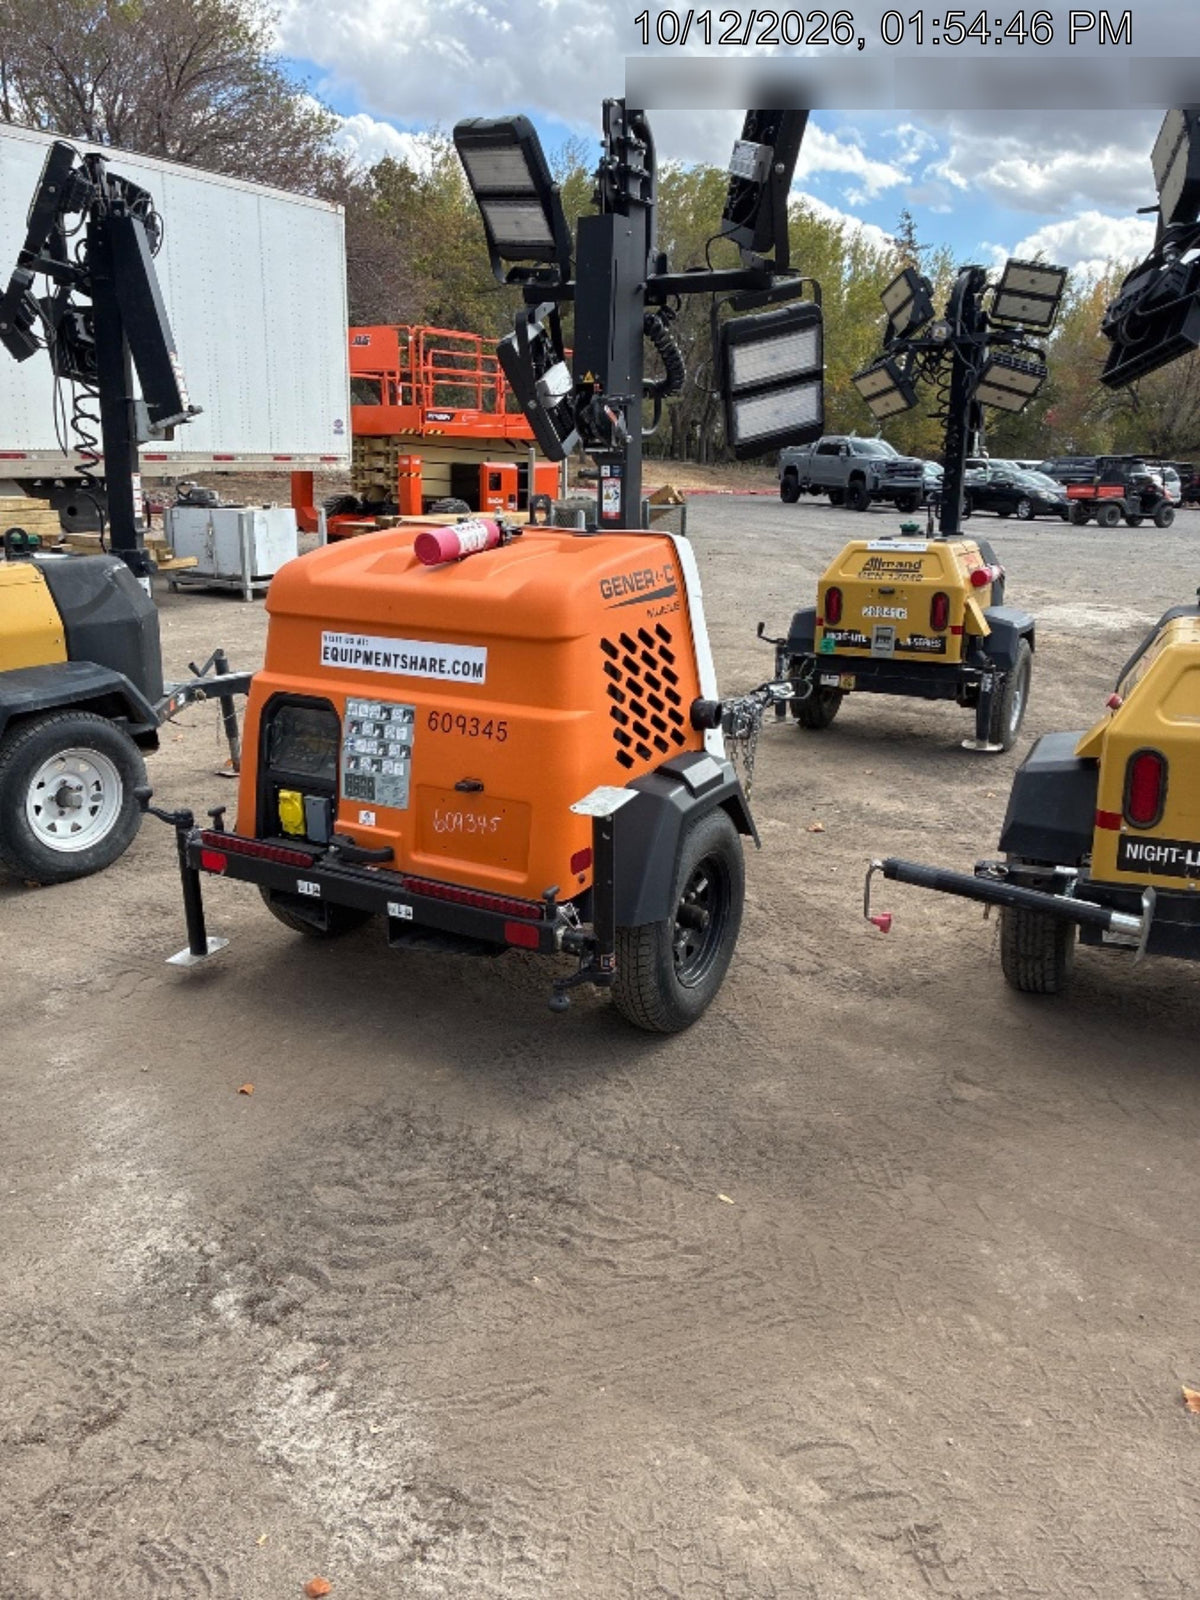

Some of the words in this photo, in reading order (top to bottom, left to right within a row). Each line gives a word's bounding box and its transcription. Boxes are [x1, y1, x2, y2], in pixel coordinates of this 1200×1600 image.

[323, 646, 484, 678] EQUIPMENTSHARE.COM
[428, 711, 508, 742] 609345
[433, 809, 502, 834] 609345
